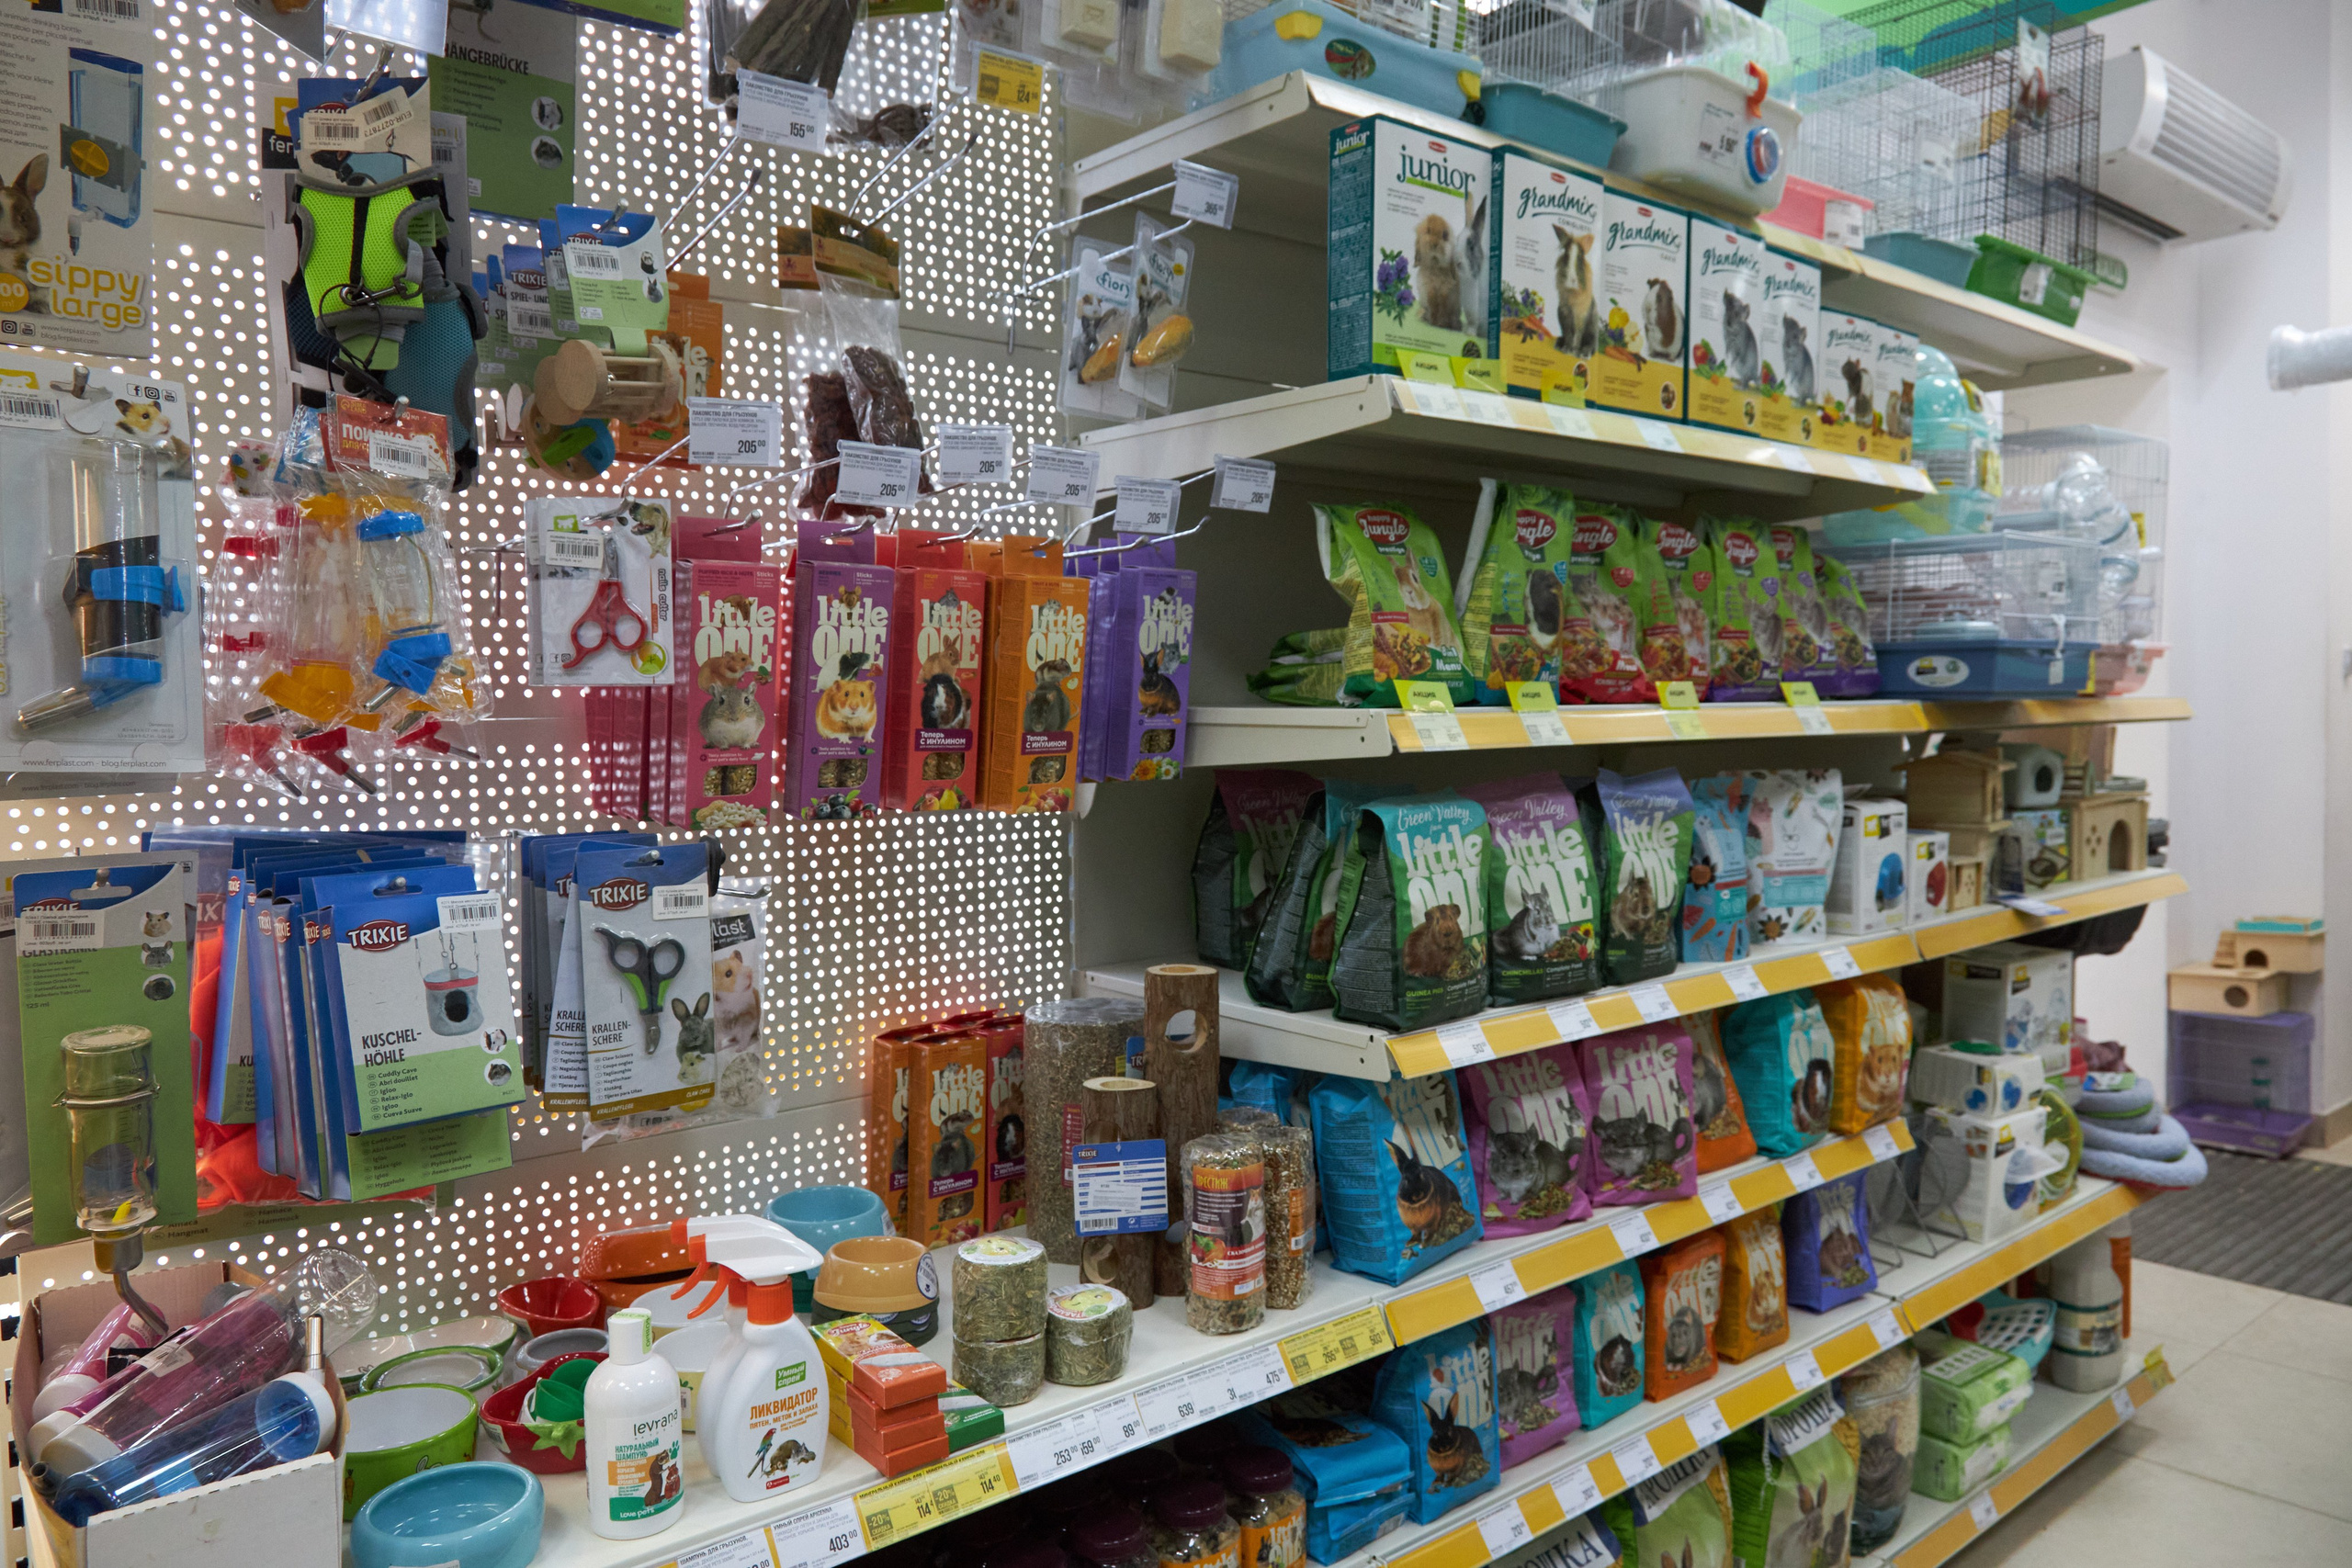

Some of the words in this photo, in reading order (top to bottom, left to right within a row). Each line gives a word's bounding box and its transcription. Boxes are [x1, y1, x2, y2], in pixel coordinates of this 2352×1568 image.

[790, 122, 806, 139] 155
[1334, 130, 1370, 155] junior
[1396, 144, 1476, 201] junior
[1204, 201, 1218, 216] 365
[1517, 185, 1598, 220] grandmix
[1606, 219, 1682, 252] grandmix
[30, 254, 140, 303] sippy
[52, 289, 141, 328] large
[738, 440, 757, 454] 205
[757, 439, 766, 448] 00
[979, 459, 995, 473] 205
[880, 483, 898, 497] 205
[1065, 482, 1080, 497] 205
[1250, 491, 1264, 504] 205
[1148, 512, 1161, 525] 205
[1363, 521, 1408, 538] Jungle
[658, 568, 666, 593] nails
[658, 593, 668, 621] cutter
[698, 593, 776, 627] little
[817, 595, 889, 627] little
[921, 598, 982, 628] little
[1142, 595, 1193, 623] little
[1031, 604, 1085, 634] little
[1412, 690, 1436, 699] АКЦИЯ
[1521, 691, 1542, 699] АКЦИЯ
[1032, 740, 1068, 749] ИНУЛИНОМ
[22, 759, 95, 768] www.ferplast.com
[101, 760, 167, 769] blog.ferplast.com
[1494, 820, 1585, 867] little
[1396, 824, 1484, 879] little
[591, 883, 647, 907] TRIXIE
[347, 924, 409, 949] TRIXIE
[592, 1021, 631, 1035] KRALLEN-
[362, 1028, 423, 1050] KUSCHEL-
[593, 1032, 623, 1046] SCHERE
[364, 1048, 406, 1068] HÖHLE
[1592, 1034, 1679, 1088] little
[378, 1068, 401, 1079] Cuddly
[401, 1066, 418, 1075] Cave
[932, 1063, 985, 1093] little
[379, 1078, 392, 1088] Abri
[393, 1075, 419, 1085] douillet
[379, 1087, 397, 1096] Igloo
[380, 1091, 413, 1103] Relax-Iglo
[381, 1102, 399, 1111] Igloo
[383, 1110, 403, 1119] Cueva
[403, 1106, 423, 1116] Suave
[1078, 1149, 1098, 1157] TRIXIE
[1195, 1174, 1229, 1190] ПРЕСТИЖ
[258, 1206, 293, 1216] Hamaca
[258, 1213, 300, 1225] Hammock
[167, 1227, 209, 1238] Hangmat
[777, 1363, 805, 1379] Умный
[1265, 1370, 1281, 1385] 475
[777, 1372, 801, 1387] спрей
[750, 1387, 818, 1420] ЛИКВИДАТОР
[1178, 1403, 1194, 1418] 639
[633, 1408, 678, 1437] levrana
[750, 1417, 772, 1429] ПЯТЕН,
[773, 1412, 792, 1424] МЕТОК
[798, 1403, 819, 1416] ЗАПАХА
[1122, 1423, 1136, 1438] 89
[615, 1437, 660, 1453] НАТУРАЛЬНЫЙ
[616, 1450, 649, 1461] ШАМПУНЬ
[1054, 1448, 1072, 1466] 253
[992, 1473, 1001, 1483] 40
[979, 1478, 995, 1495] 114
[637, 1507, 655, 1518] pets
[916, 1501, 932, 1519] 114
[773, 1517, 793, 1531] УМНЫЙ
[868, 1513, 891, 1528] -20%
[848, 1529, 858, 1540] 00
[829, 1533, 850, 1553] 403
[680, 1551, 707, 1565] ШАМПУНЬ
[707, 1546, 718, 1557] ДЛЯ
